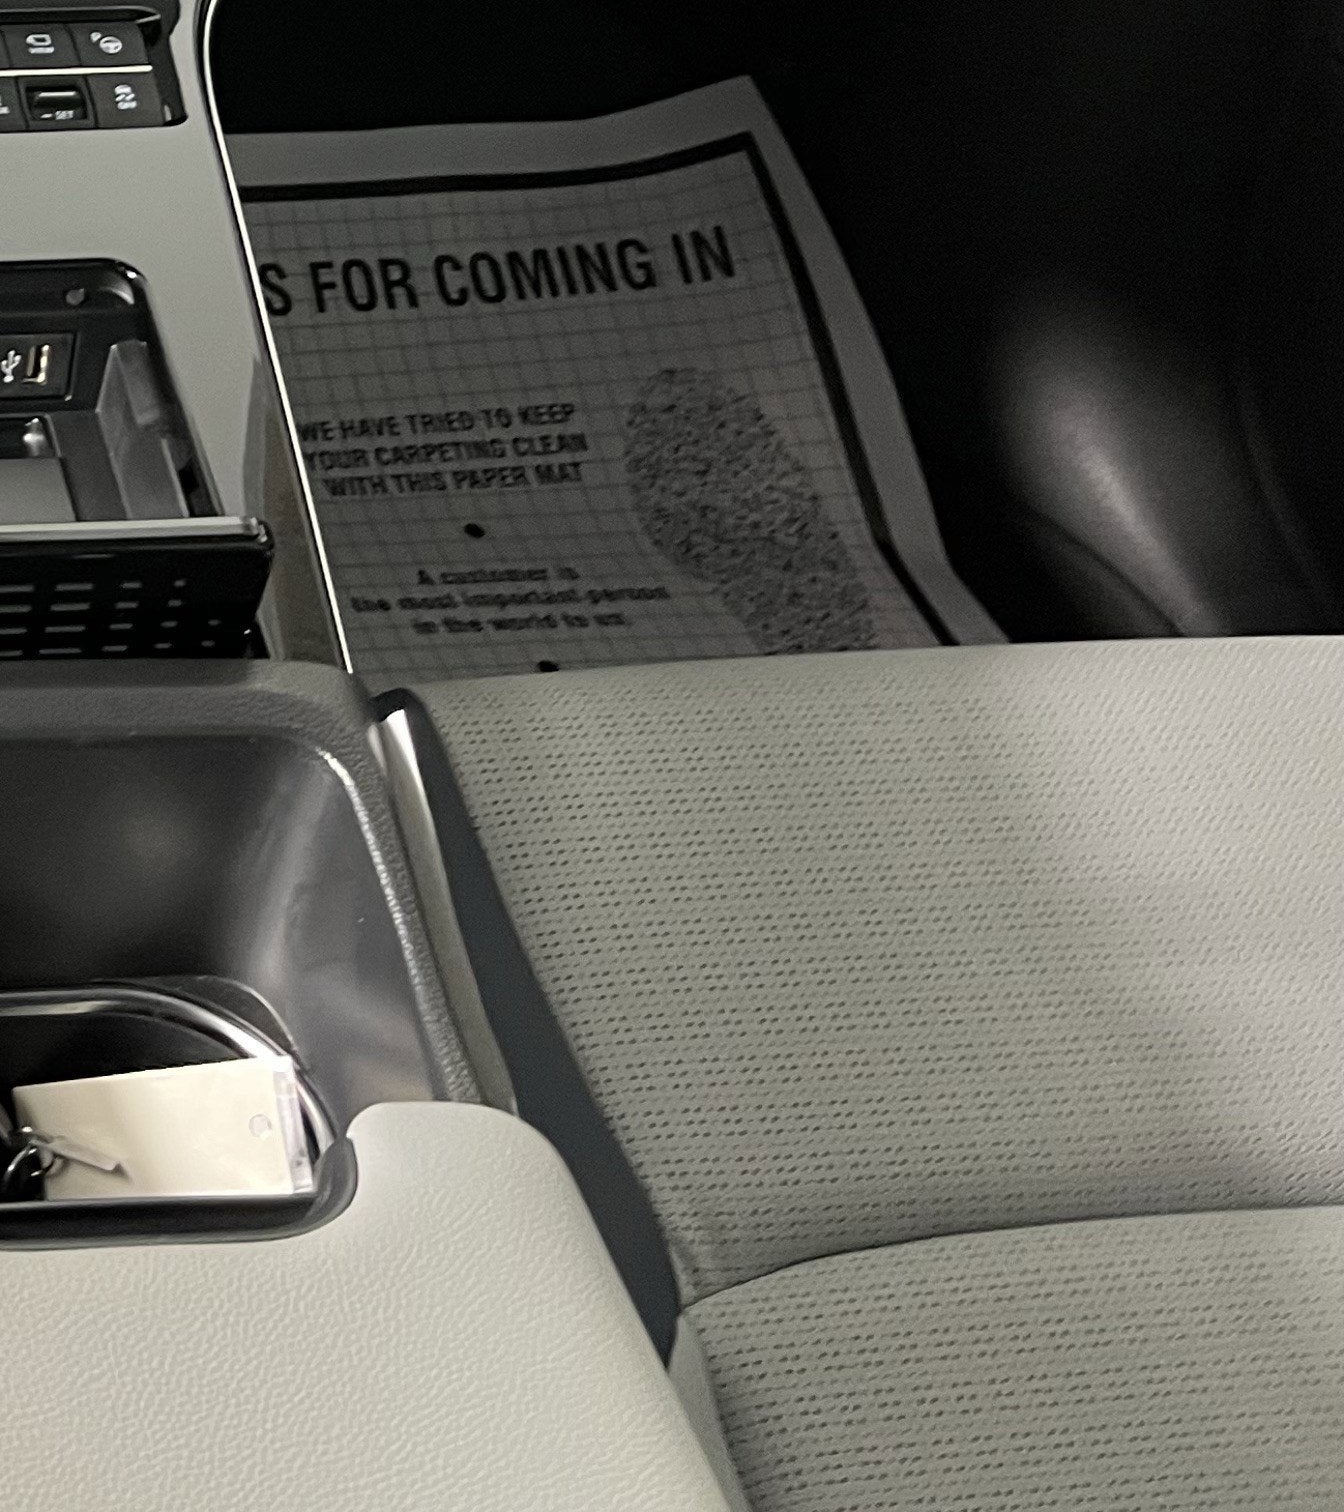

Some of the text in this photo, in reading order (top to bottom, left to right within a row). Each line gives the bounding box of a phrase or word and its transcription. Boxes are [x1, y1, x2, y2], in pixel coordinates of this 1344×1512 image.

[308, 257, 419, 314] FOR
[433, 238, 657, 308] COMING
[670, 224, 736, 285] IN
[339, 416, 401, 438] HAVE
[404, 410, 475, 435] TRIED
[480, 407, 511, 430] TO
[517, 402, 576, 426] KEEP
[374, 439, 507, 466] CARPETING
[512, 433, 588, 458] CLEAN
